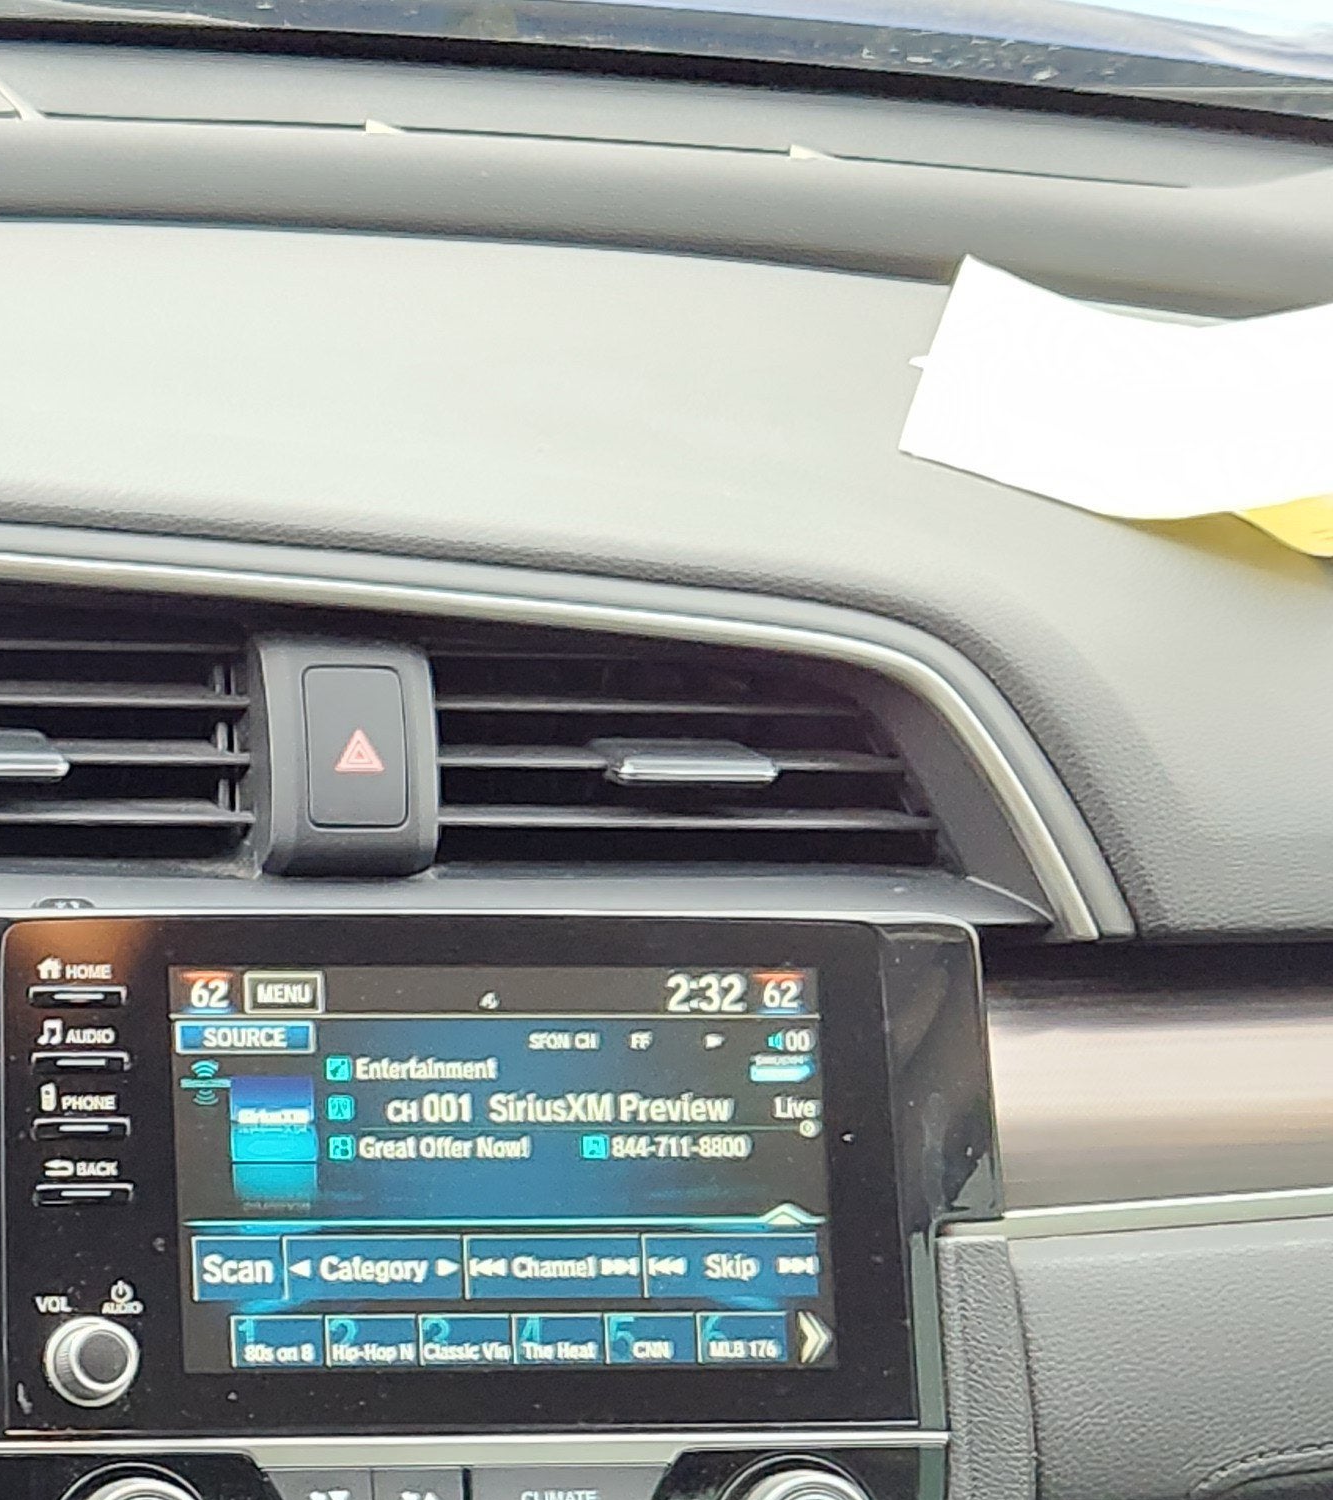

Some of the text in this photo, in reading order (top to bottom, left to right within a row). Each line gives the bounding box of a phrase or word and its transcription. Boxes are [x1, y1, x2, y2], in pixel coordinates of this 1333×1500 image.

[64, 963, 113, 980] HOME
[190, 980, 231, 1009] 62
[256, 983, 312, 1004] MENU
[665, 973, 747, 1013] 2:32
[762, 980, 803, 1009] 62
[64, 1027, 116, 1046] AUDIO
[202, 1026, 288, 1048] SOURCE
[354, 1057, 498, 1081] Entertainment
[61, 1095, 117, 1111] PHONE
[386, 1091, 734, 1124] CH 001 SiriusXM Preview
[773, 1095, 820, 1120] Live
[358, 1135, 532, 1160] Great Offer Now!
[610, 1135, 753, 1160] 844-711-8800
[75, 1160, 118, 1177] BACK
[202, 1254, 274, 1284] Scan
[319, 1254, 429, 1284] Category
[511, 1254, 597, 1279] Channel
[704, 1254, 759, 1283] Skip
[35, 1295, 72, 1314] VOL
[101, 1301, 145, 1315] AUDIO
[243, 1343, 275, 1363] 80s
[276, 1346, 299, 1362] on
[332, 1342, 416, 1364] Hip-Hop N
[423, 1340, 511, 1362] Classic Vin
[521, 1340, 598, 1361] The Heat
[632, 1340, 675, 1361] CNN
[709, 1340, 746, 1360] MLB
